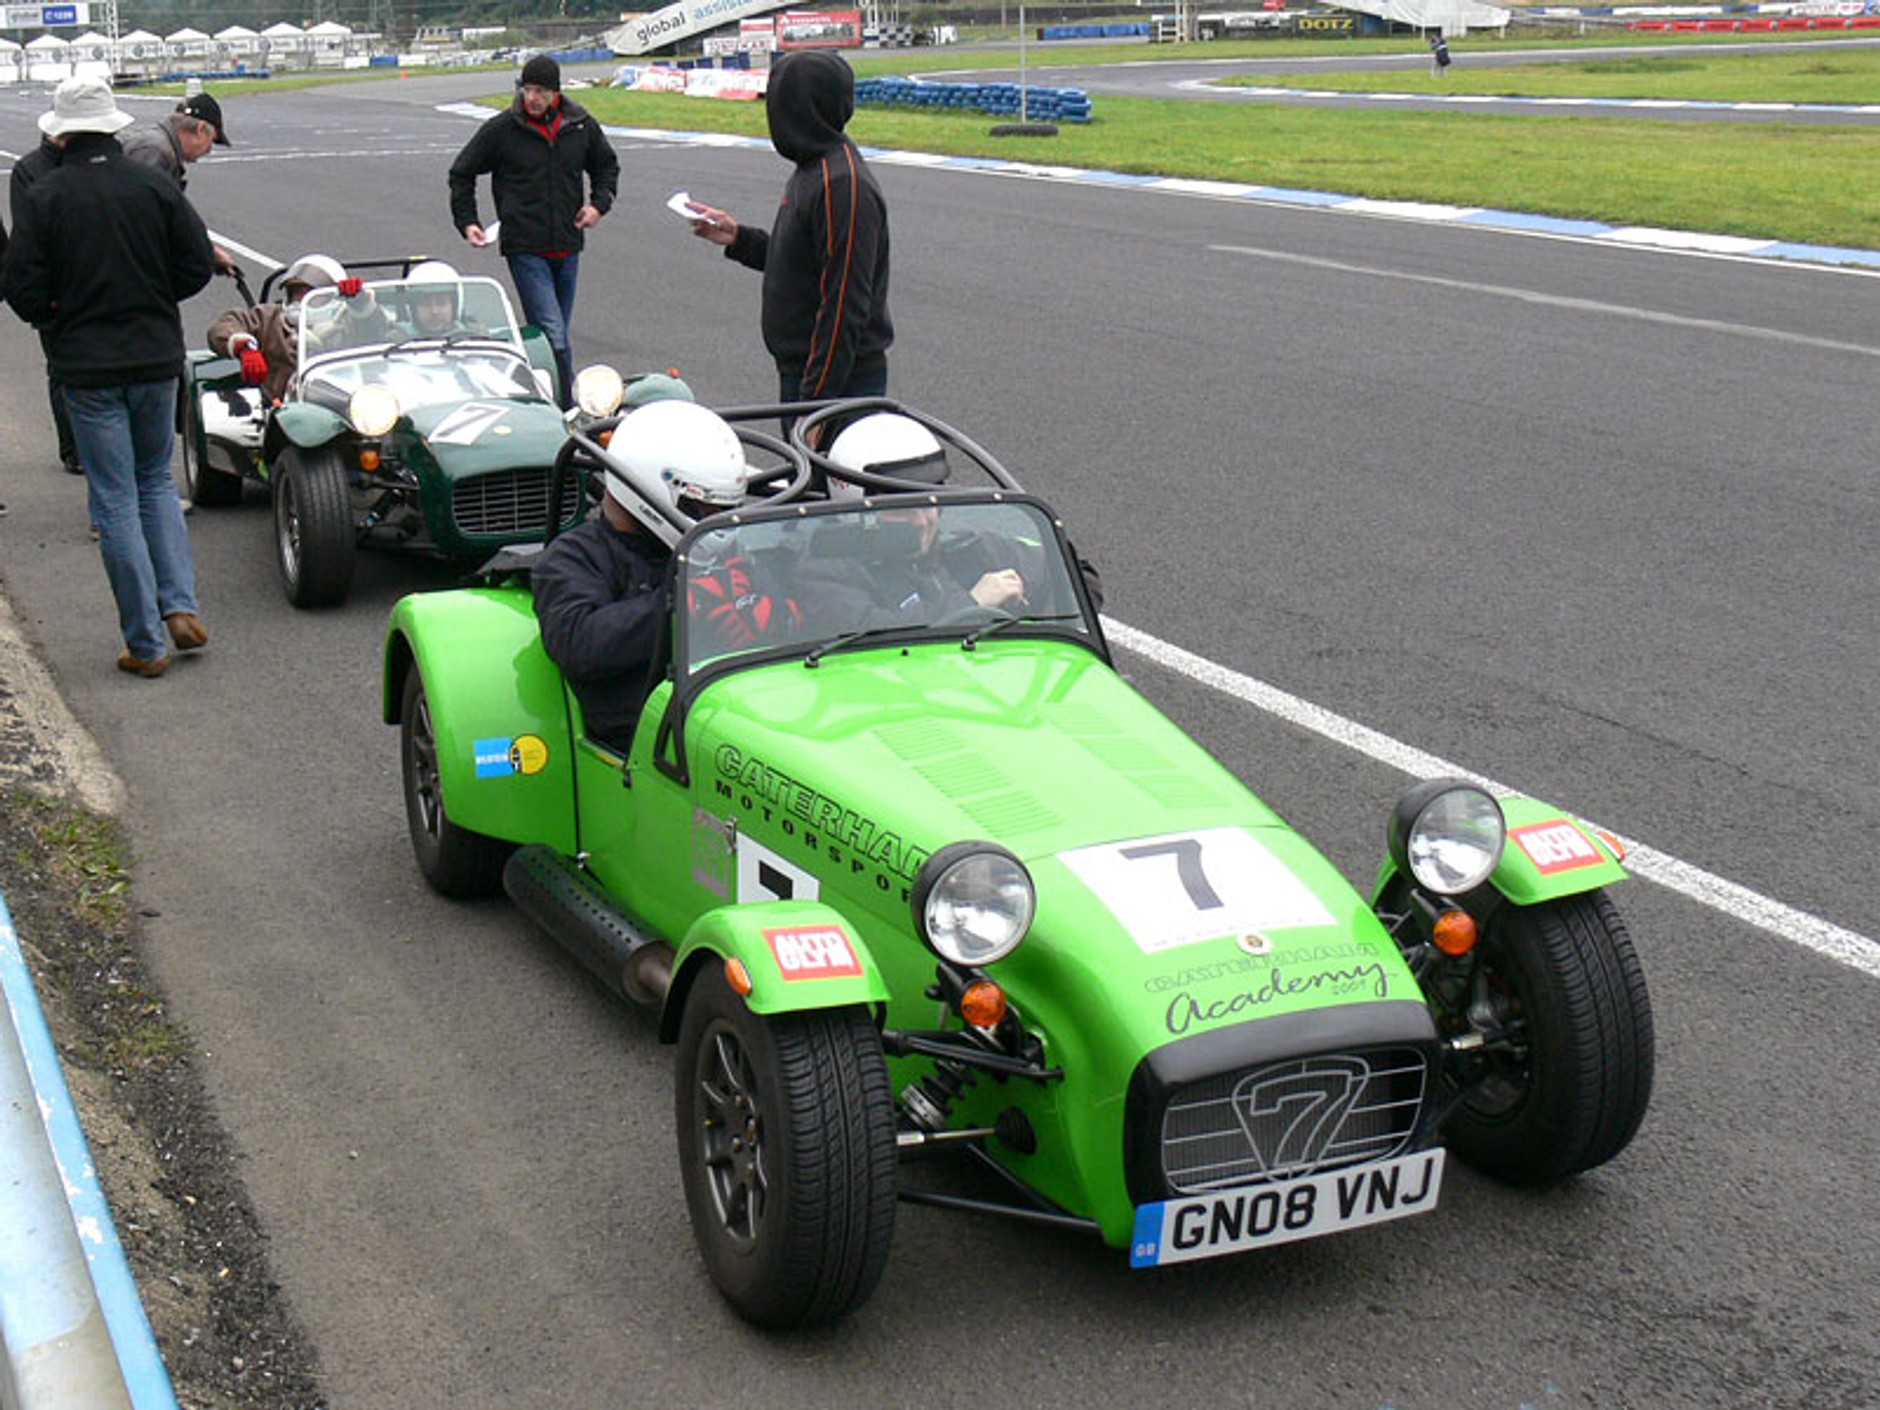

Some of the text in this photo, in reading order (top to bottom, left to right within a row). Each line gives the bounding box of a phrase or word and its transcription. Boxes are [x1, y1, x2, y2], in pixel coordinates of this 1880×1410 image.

[637, 12, 686, 46] global
[1300, 19, 1353, 30] DOTZ
[436, 405, 501, 438] 7
[1117, 838, 1224, 910] 7
[1173, 1158, 1433, 1250] GN08 VNJ
